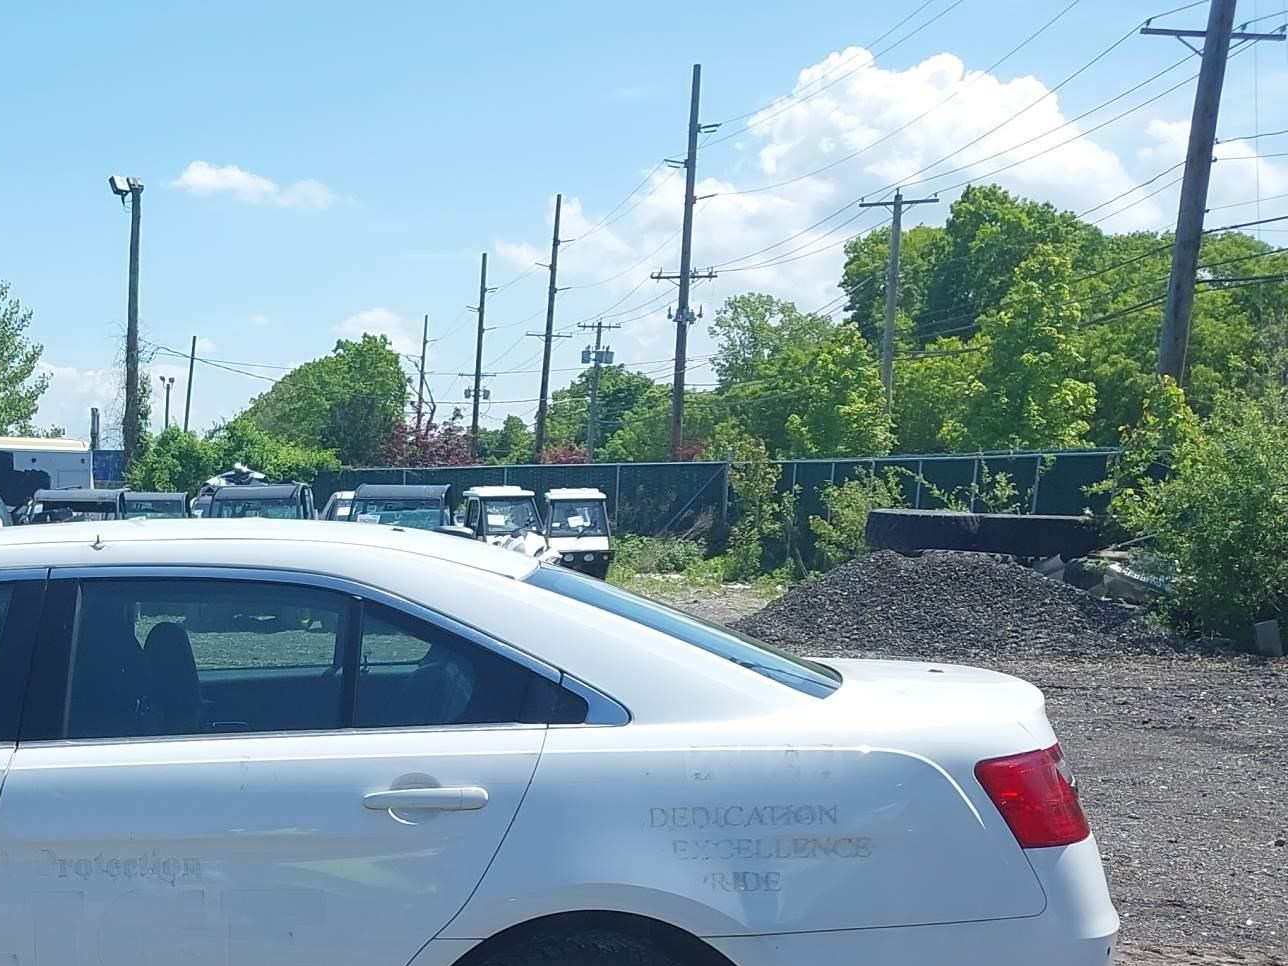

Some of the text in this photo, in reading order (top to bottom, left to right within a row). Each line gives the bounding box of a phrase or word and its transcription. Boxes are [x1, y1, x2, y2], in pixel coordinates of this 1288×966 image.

[648, 804, 840, 830] DEDICATION
[672, 836, 873, 861] EXCELLENCE
[703, 870, 783, 893] RIDE
